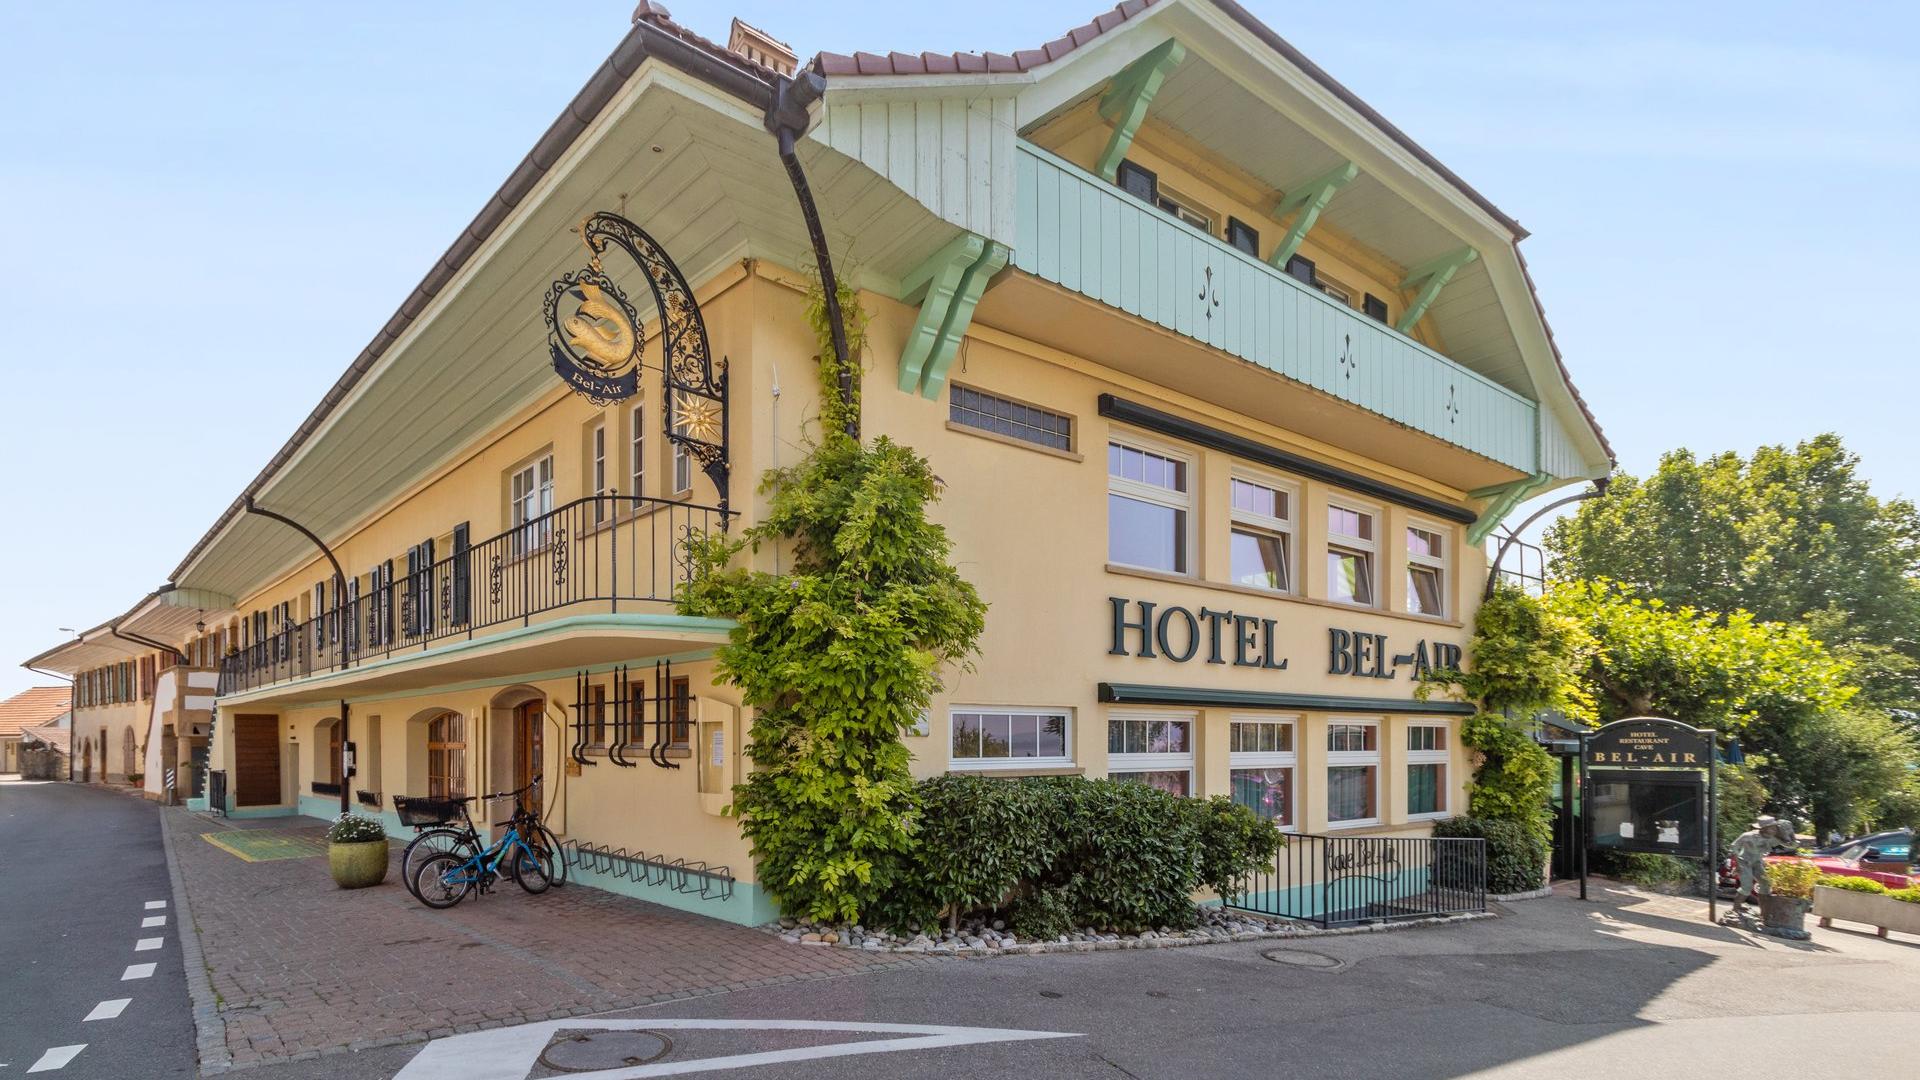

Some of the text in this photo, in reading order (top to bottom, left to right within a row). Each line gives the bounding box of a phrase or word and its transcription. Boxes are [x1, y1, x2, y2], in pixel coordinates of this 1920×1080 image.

[572, 372, 622, 394] Bel-Air
[1109, 597, 1462, 682] HOTEL BEL-AIR
[1594, 752, 1697, 762] BEL-AIR
